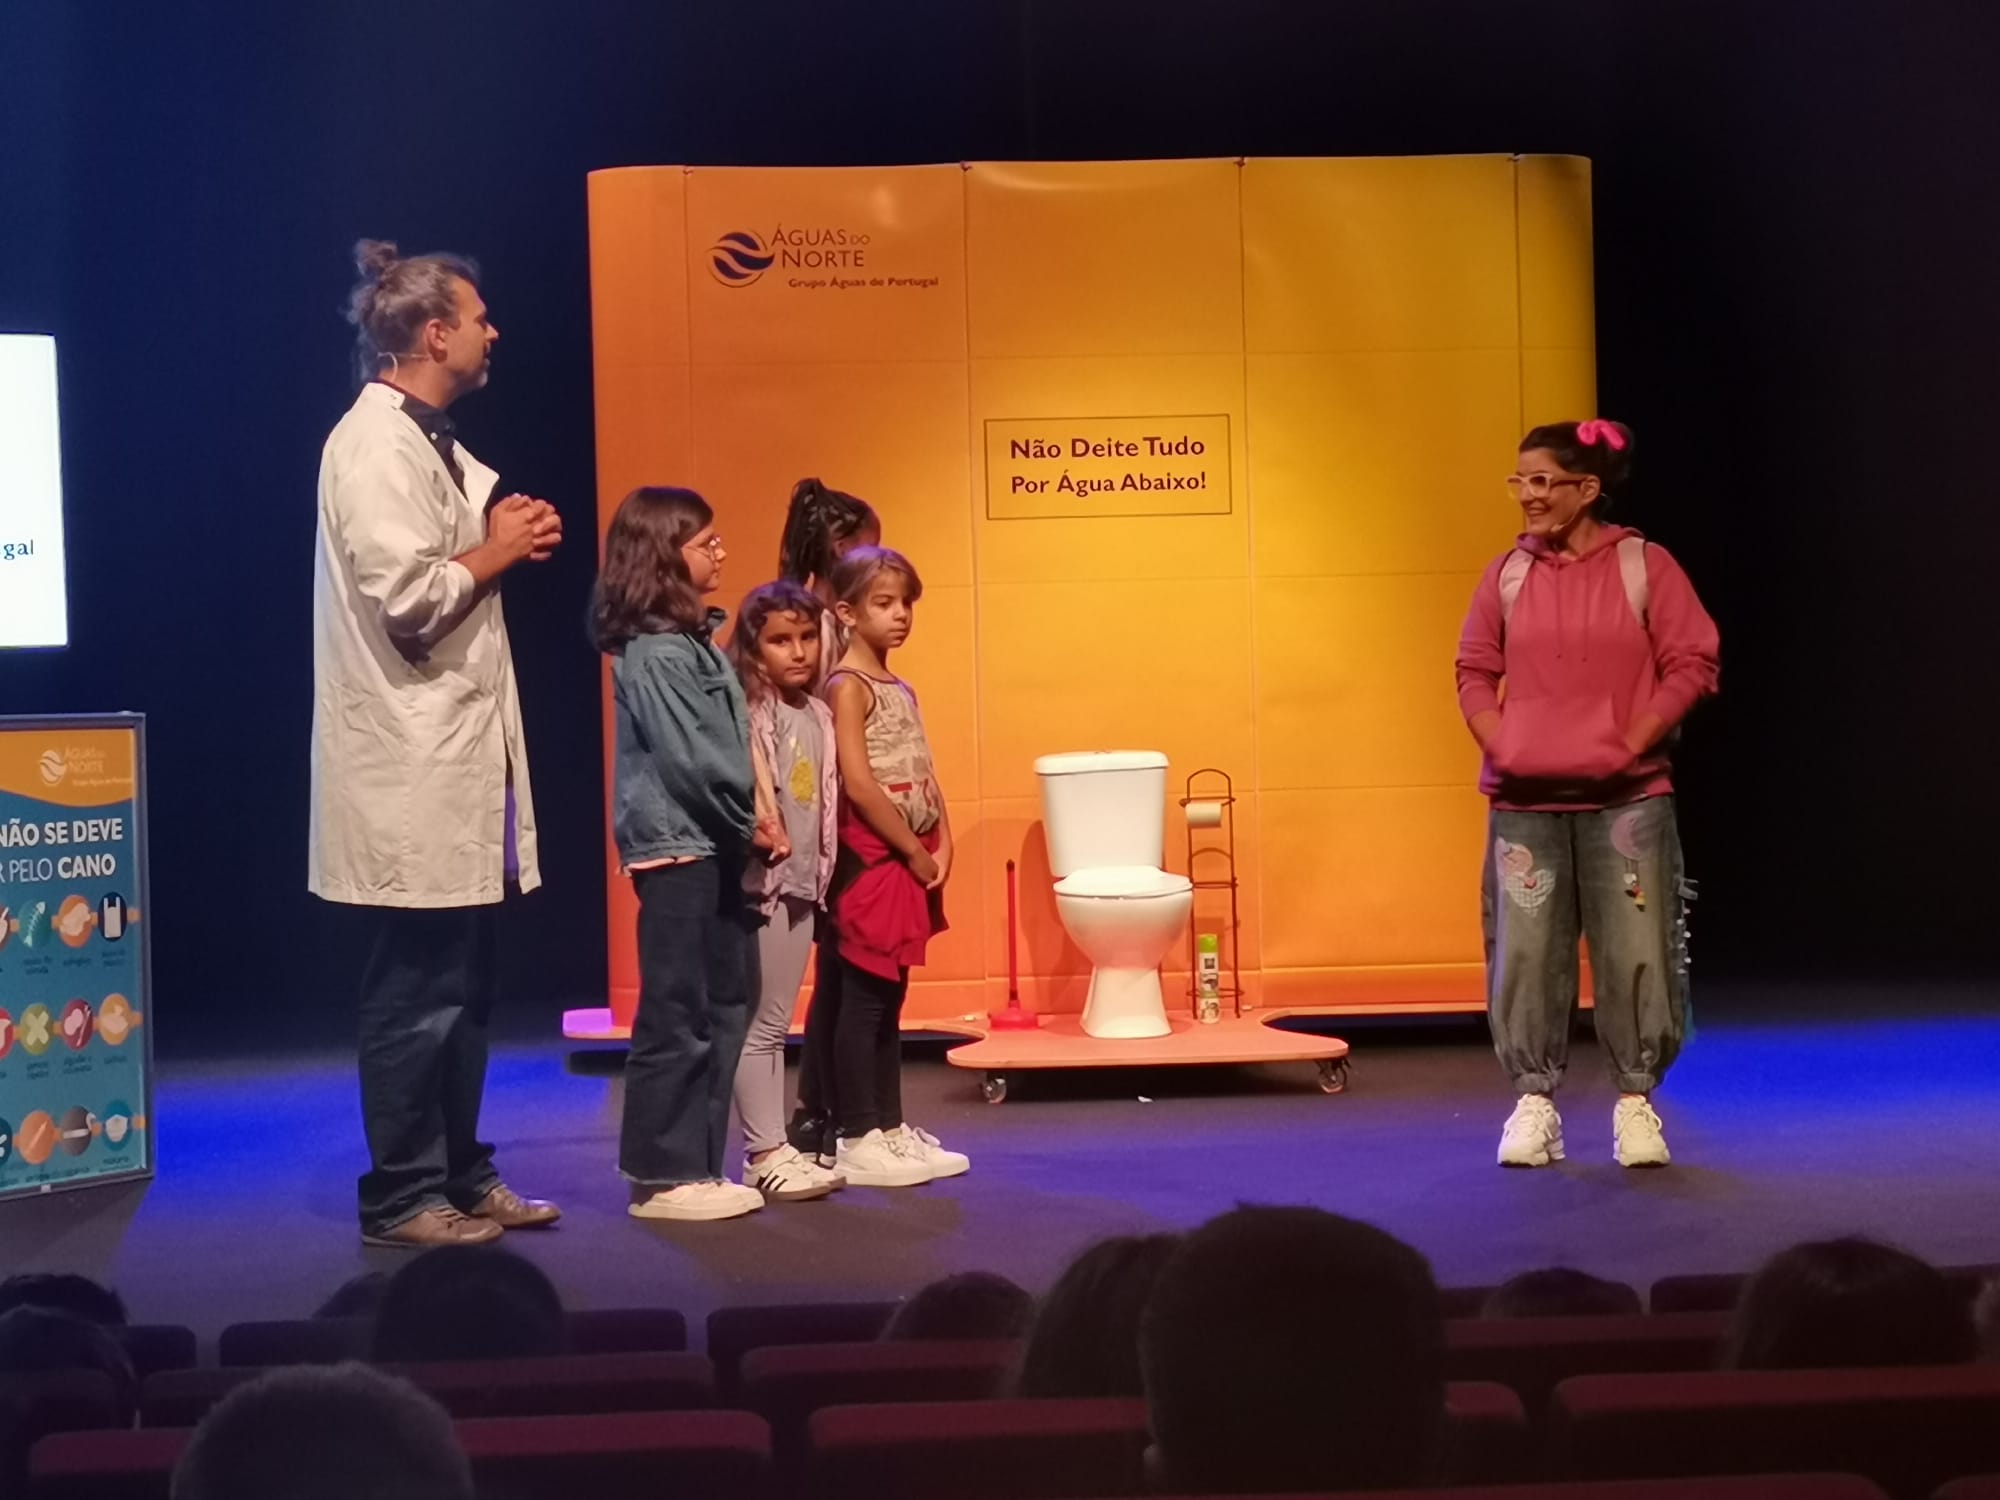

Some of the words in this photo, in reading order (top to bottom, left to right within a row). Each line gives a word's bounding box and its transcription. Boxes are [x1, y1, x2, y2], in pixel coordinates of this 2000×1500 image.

[771, 224, 847, 247] ÁGUAS
[782, 249, 865, 268] NORTE
[788, 278, 826, 289] Grupo
[830, 276, 865, 289] Águas
[869, 277, 884, 286] de
[887, 277, 939, 288] Portugal
[1010, 438, 1061, 459] Não
[1071, 437, 1139, 458] Deite
[1142, 435, 1205, 456] Tudo
[1011, 475, 1050, 494] Por
[1056, 469, 1115, 497] Água
[1120, 471, 1207, 491] Abaixo!
[44, 821, 69, 845] SE
[72, 818, 123, 843] DEVE
[9, 858, 53, 882] PELO
[57, 853, 116, 879] CANO
